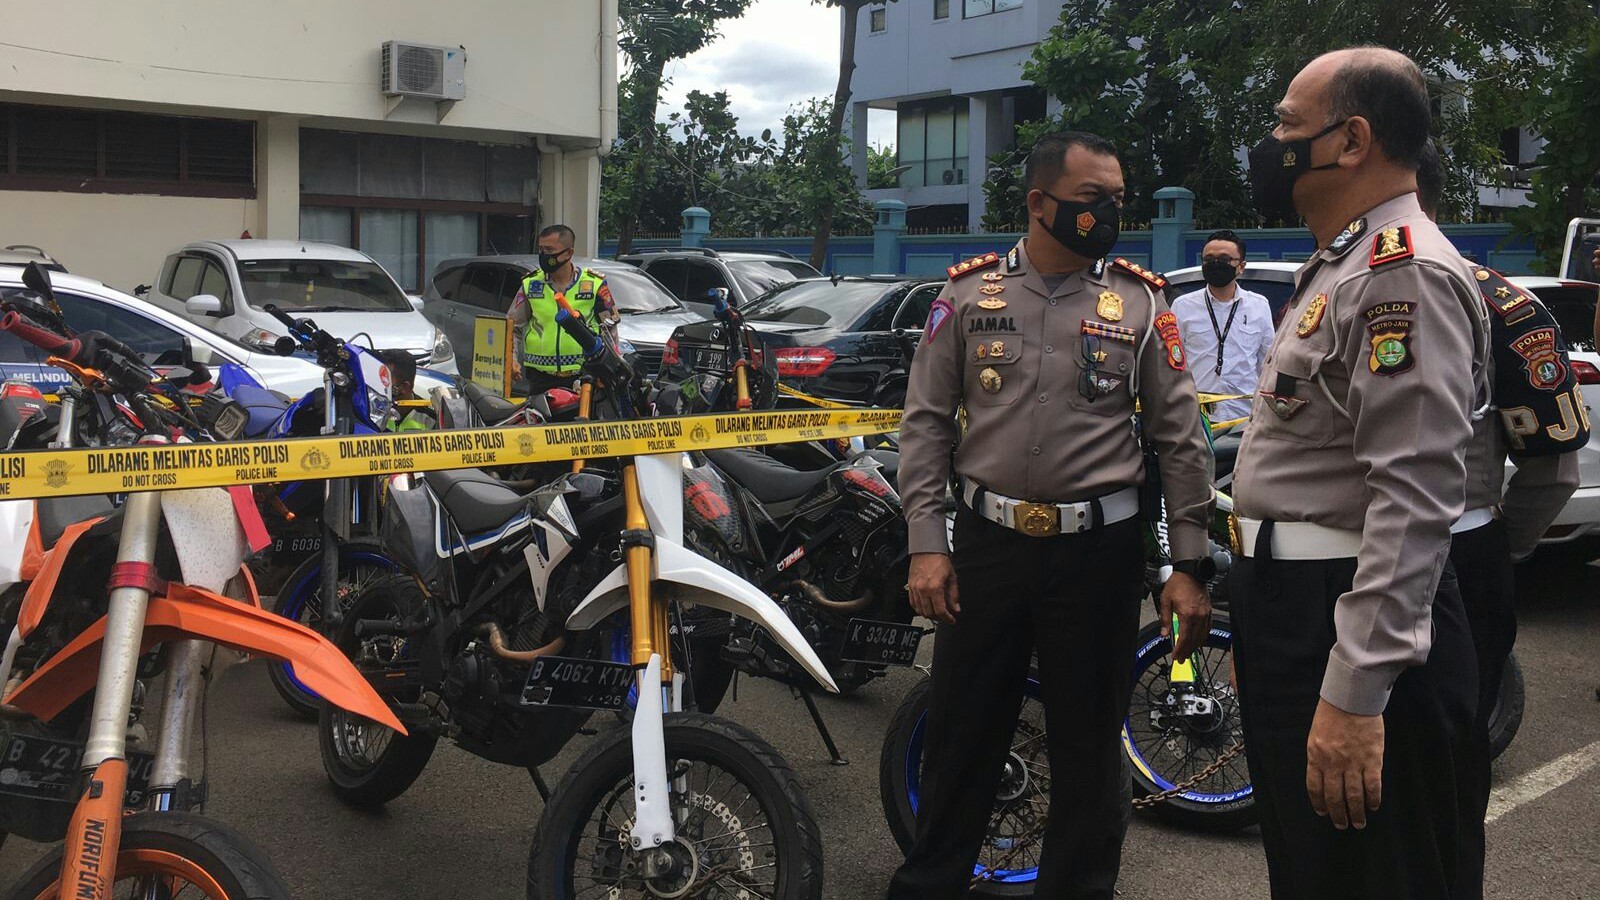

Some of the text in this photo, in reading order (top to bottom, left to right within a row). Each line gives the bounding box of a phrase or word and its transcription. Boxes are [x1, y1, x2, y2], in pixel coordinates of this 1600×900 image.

[1077, 229, 1088, 237] TNI
[1367, 303, 1410, 319] POLDA
[968, 317, 1016, 333] JAMAL
[1517, 331, 1551, 350] POLDA
[715, 413, 831, 434] DILARANG MELINTAS GARIS POLISI
[545, 421, 682, 445] DILARANG MELINTAS GARIS POLISI
[737, 433, 768, 444] DO NOT CROSS
[798, 429, 814, 438] POLICE
[340, 432, 505, 459] DILARANG MELINTAS GARIS POLISI
[571, 444, 608, 456] DO NOT CROSS
[647, 439, 676, 450] POLICE LINE
[88, 444, 289, 474] DILARANG MELINTAS GARIS POLISI
[369, 457, 414, 471] DO NOT CROSS
[461, 452, 496, 464] POLICE LINE
[122, 473, 177, 488] DO NOT CROSS
[235, 467, 277, 480] POLICE LINE
[292, 538, 320, 551] 6036
[851, 624, 862, 641] K
[901, 630, 919, 647] ME
[532, 661, 633, 687] B 4062 KTW
[8, 740, 26, 762] B
[76, 819, 105, 900] NORIFUM
